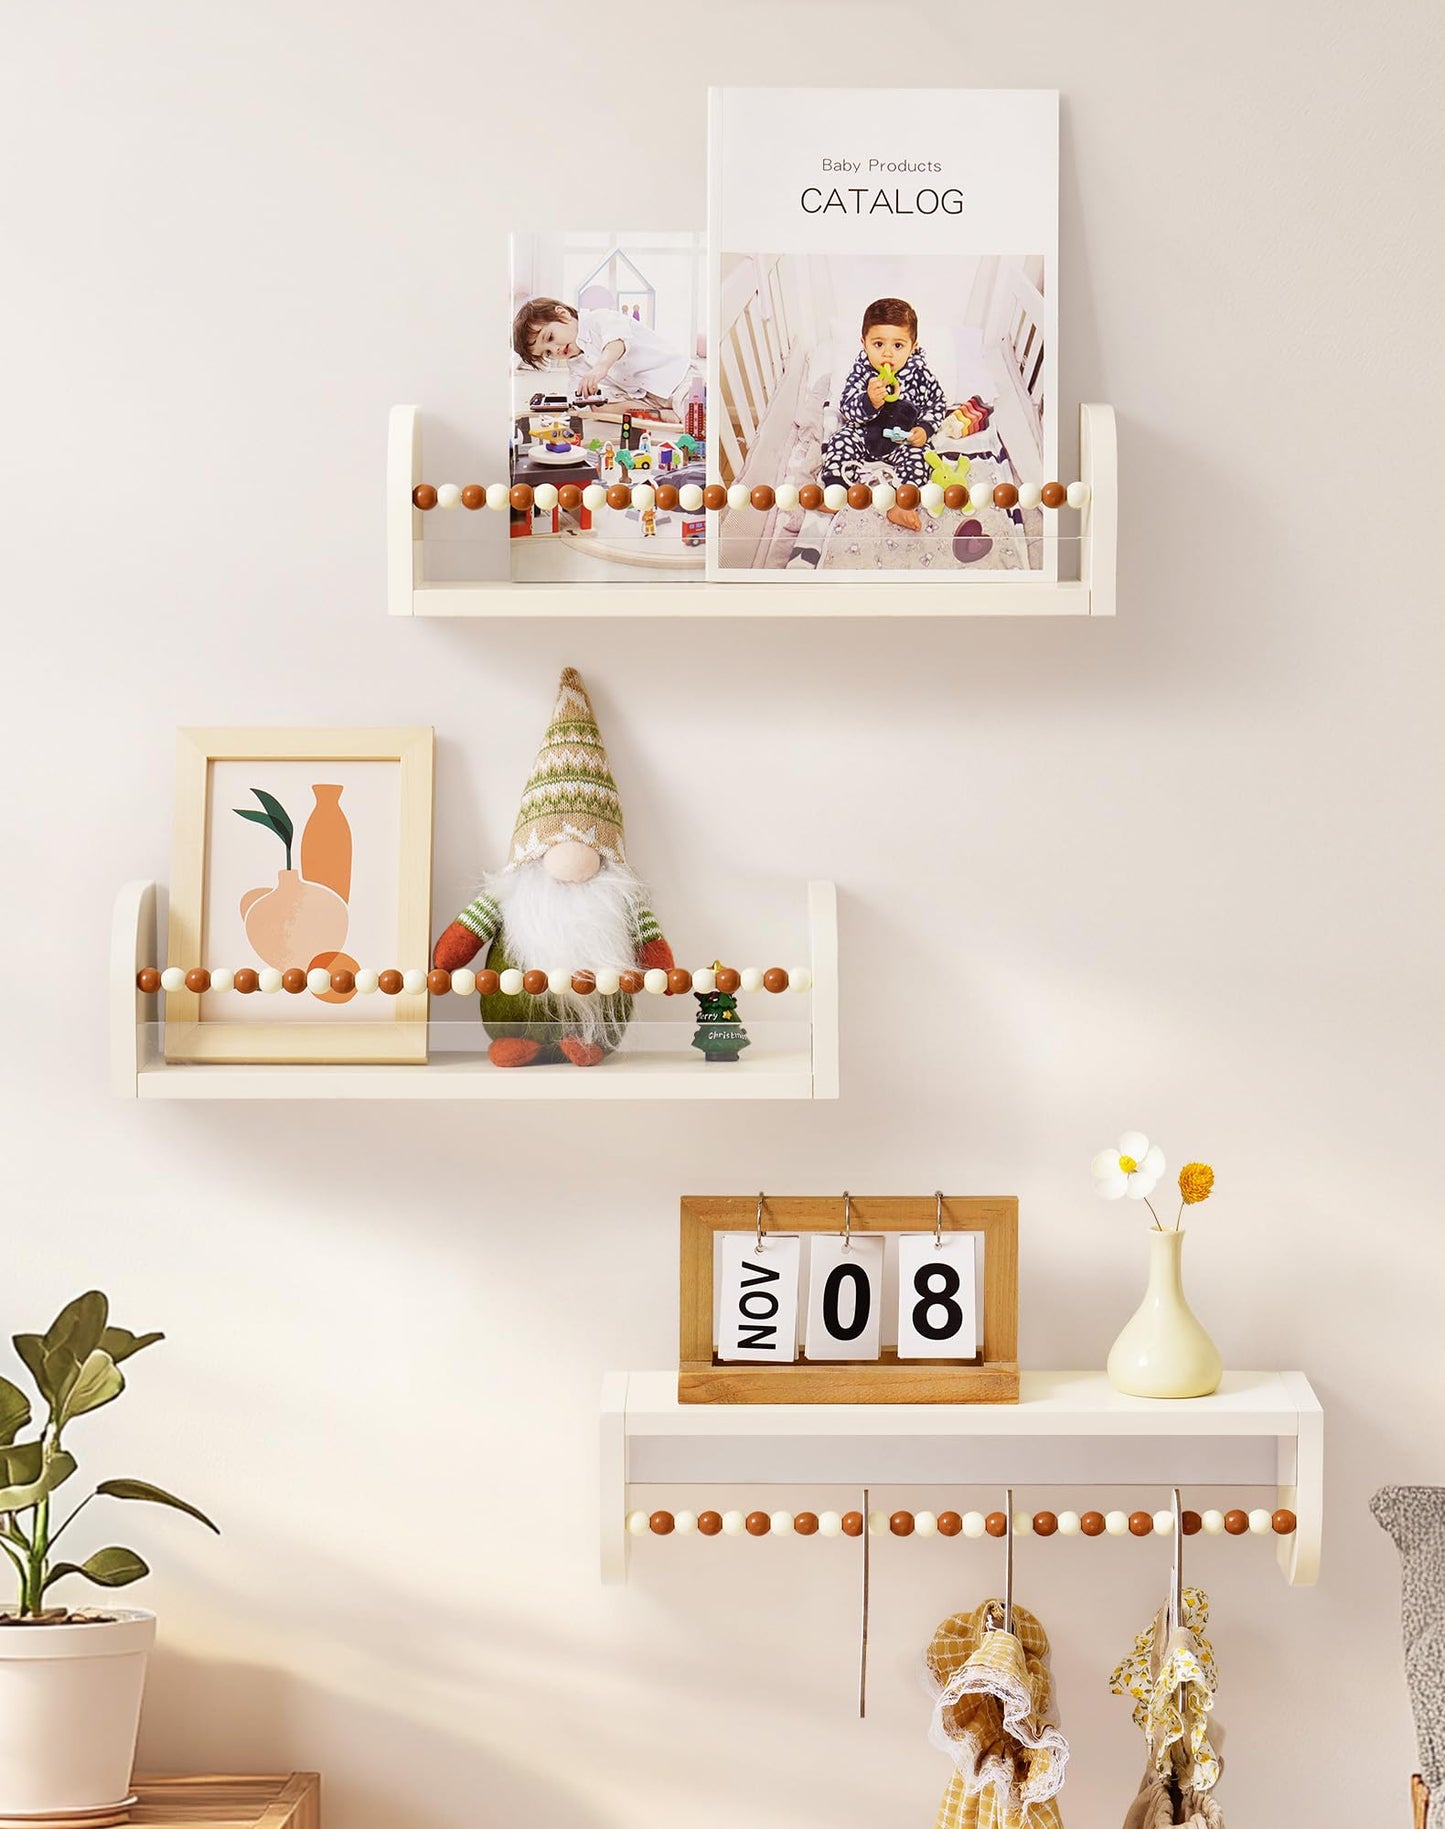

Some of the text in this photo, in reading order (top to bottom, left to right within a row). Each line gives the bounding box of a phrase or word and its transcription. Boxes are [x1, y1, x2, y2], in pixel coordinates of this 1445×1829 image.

[822, 158, 942, 174] Baby Products
[801, 187, 964, 215] CATALOG
[737, 1261, 780, 1350] NOV
